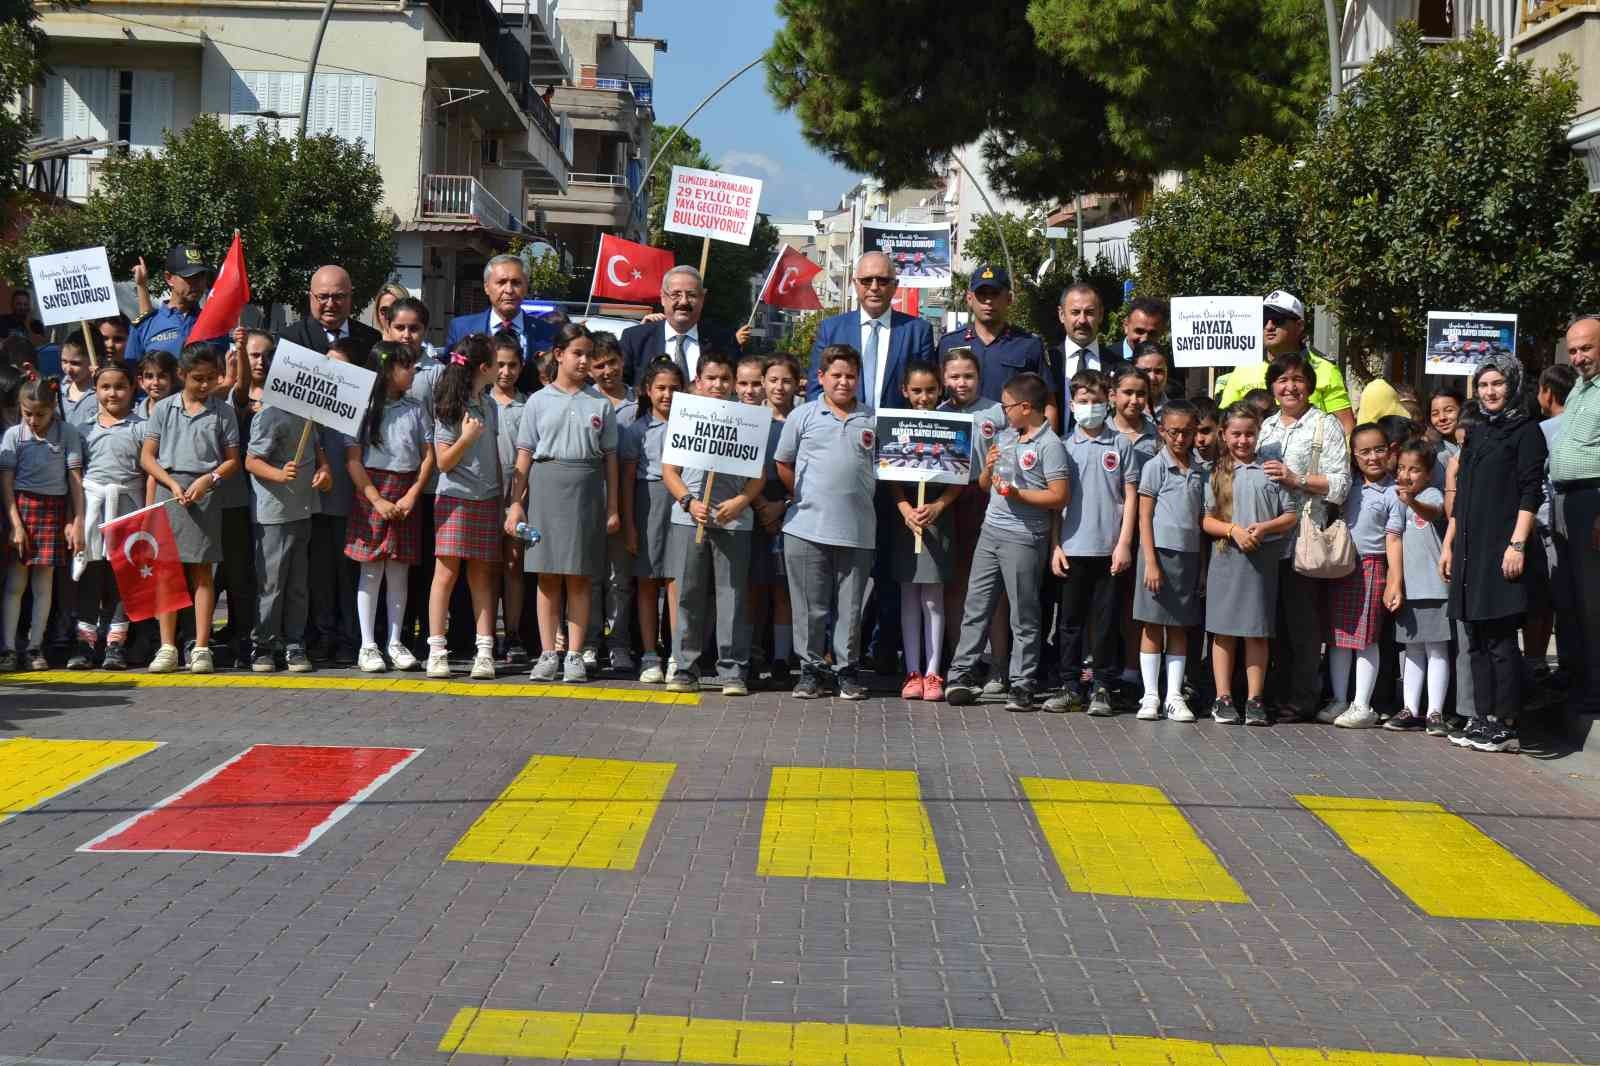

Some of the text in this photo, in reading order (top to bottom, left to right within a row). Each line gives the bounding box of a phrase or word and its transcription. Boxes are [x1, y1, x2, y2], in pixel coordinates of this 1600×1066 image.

[675, 197, 695, 211] YAYA
[677, 186, 692, 197] 29
[736, 195, 752, 207] DE
[55, 274, 90, 292] HAYATA
[42, 286, 111, 310] SAYGI DURUŞU
[1192, 320, 1233, 335] HAYATA
[1177, 335, 1256, 351] SAYGI DURUŞU
[295, 370, 338, 399] HAYATA
[271, 378, 357, 420] SAYGI DURUŞU
[694, 420, 738, 442] HAYATA
[671, 433, 760, 461] SAYGI DURUŞU
